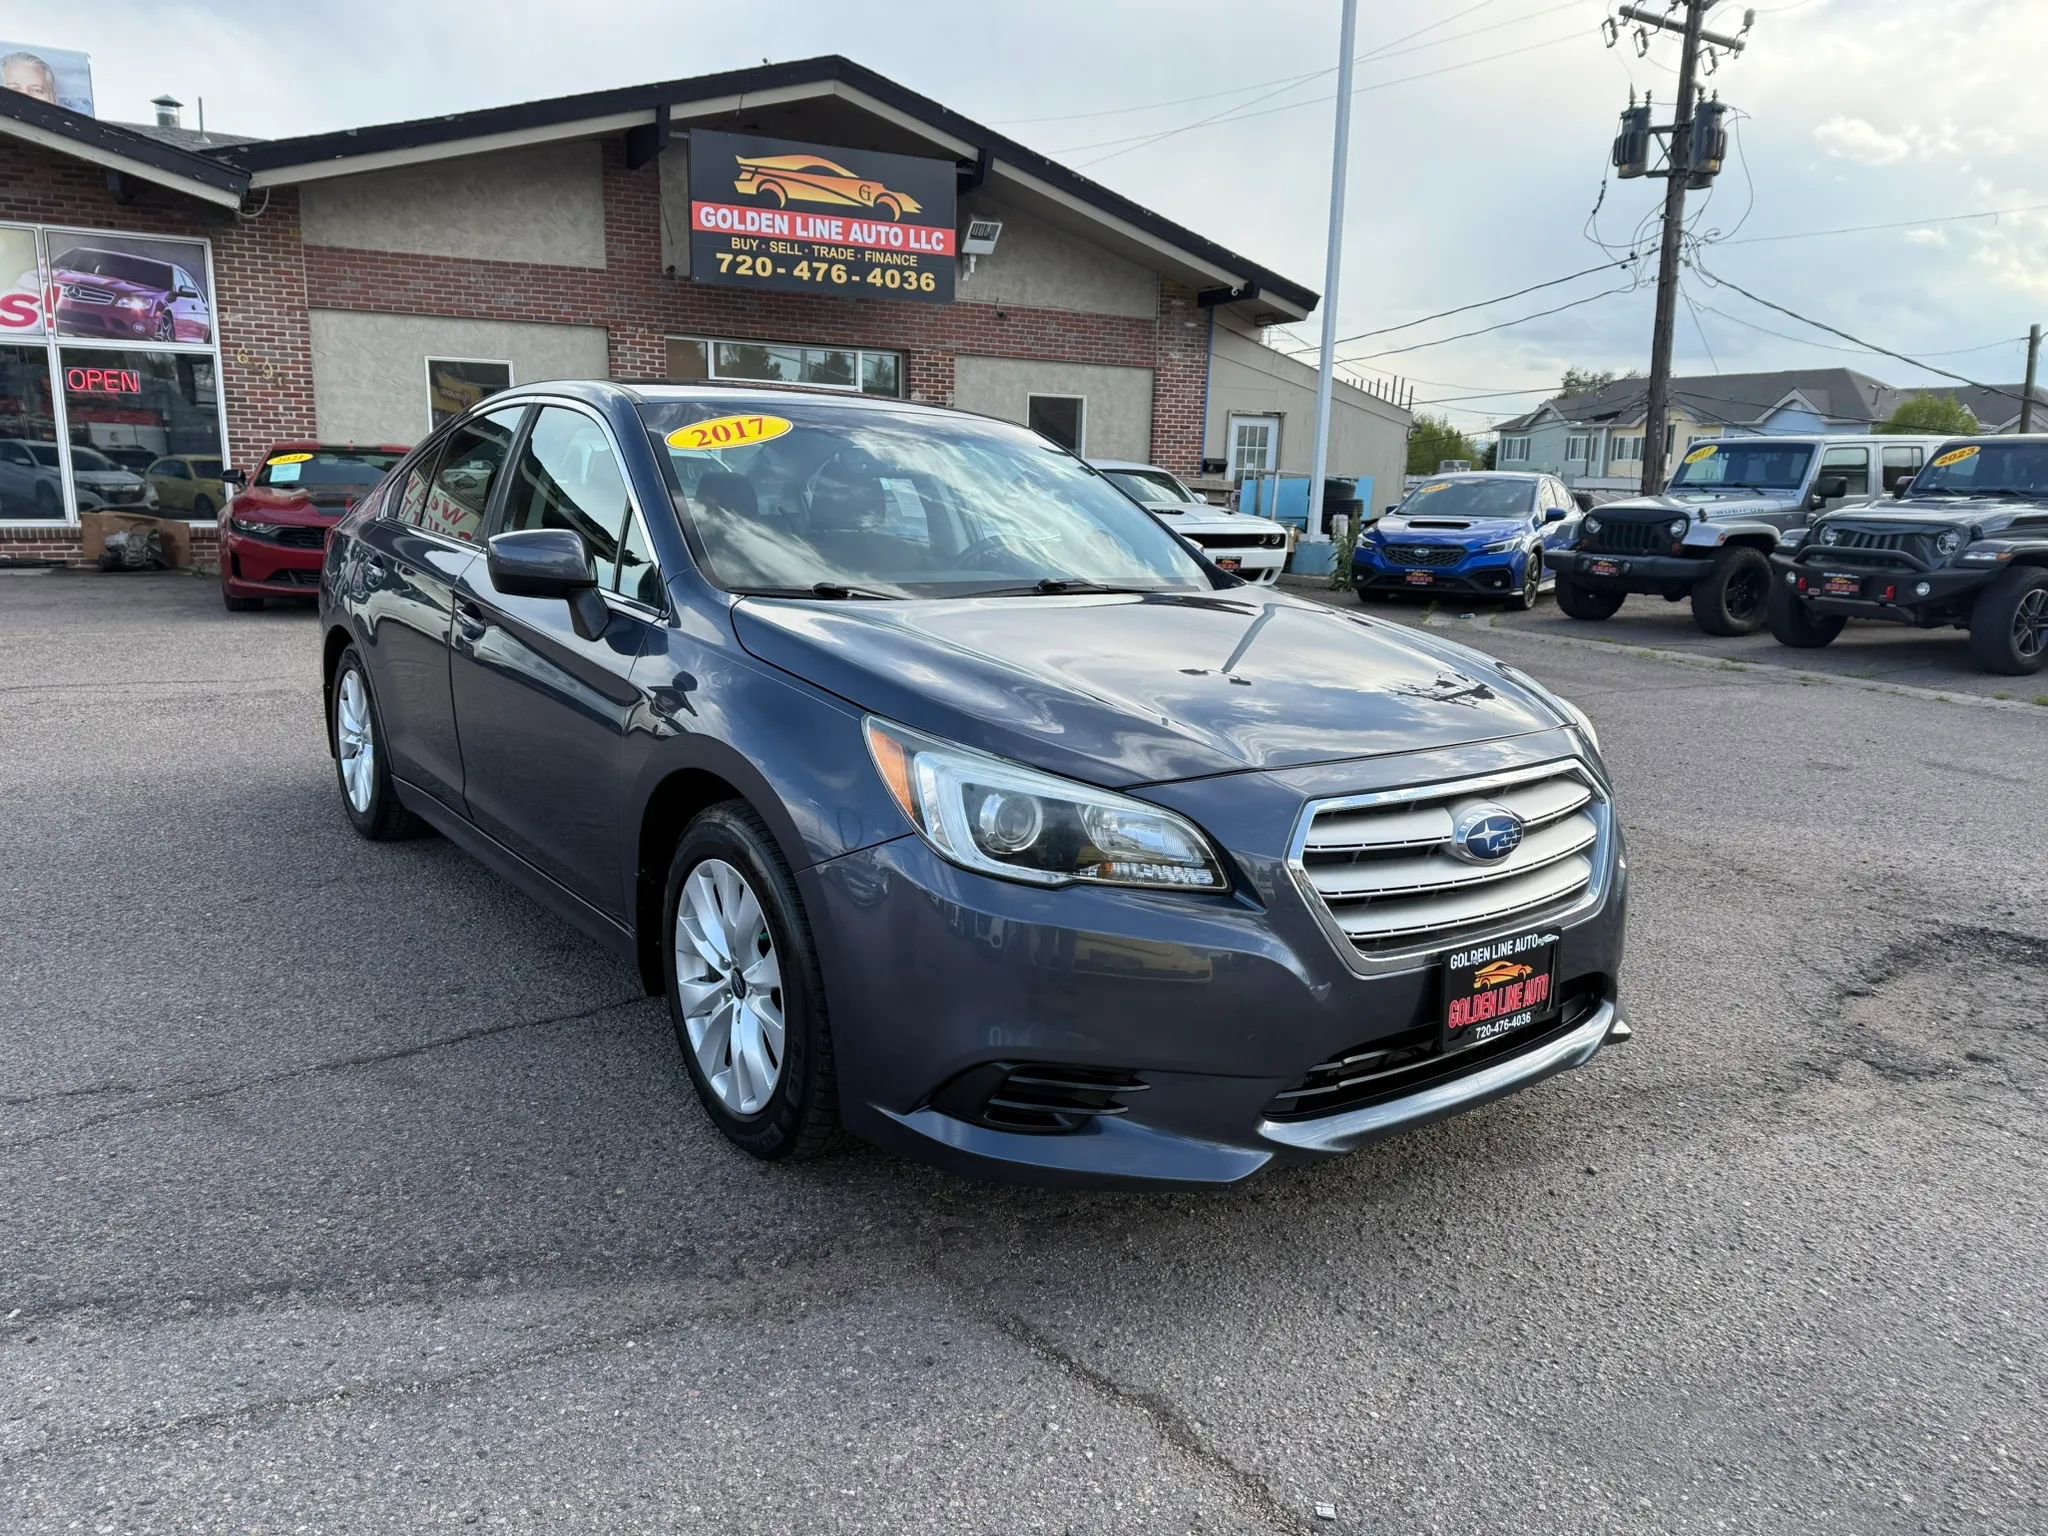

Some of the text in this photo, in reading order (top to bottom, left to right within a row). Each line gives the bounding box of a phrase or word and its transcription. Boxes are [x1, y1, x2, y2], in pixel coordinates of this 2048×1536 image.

[700, 206, 945, 252] GOLDEN LINE AUTO LLC
[731, 237, 918, 266] BUY SELL TRADE FINANCE
[716, 252, 936, 292] 720-476-4036
[67, 369, 139, 393] OPEN
[691, 417, 763, 447] 2017
[1938, 447, 1976, 465] 2023
[1450, 933, 1538, 970] GOLDEN LINE AUTO
[1448, 973, 1550, 1029] GOLDEN LINE AUTO
[1475, 1012, 1531, 1040] 720-476-4036
